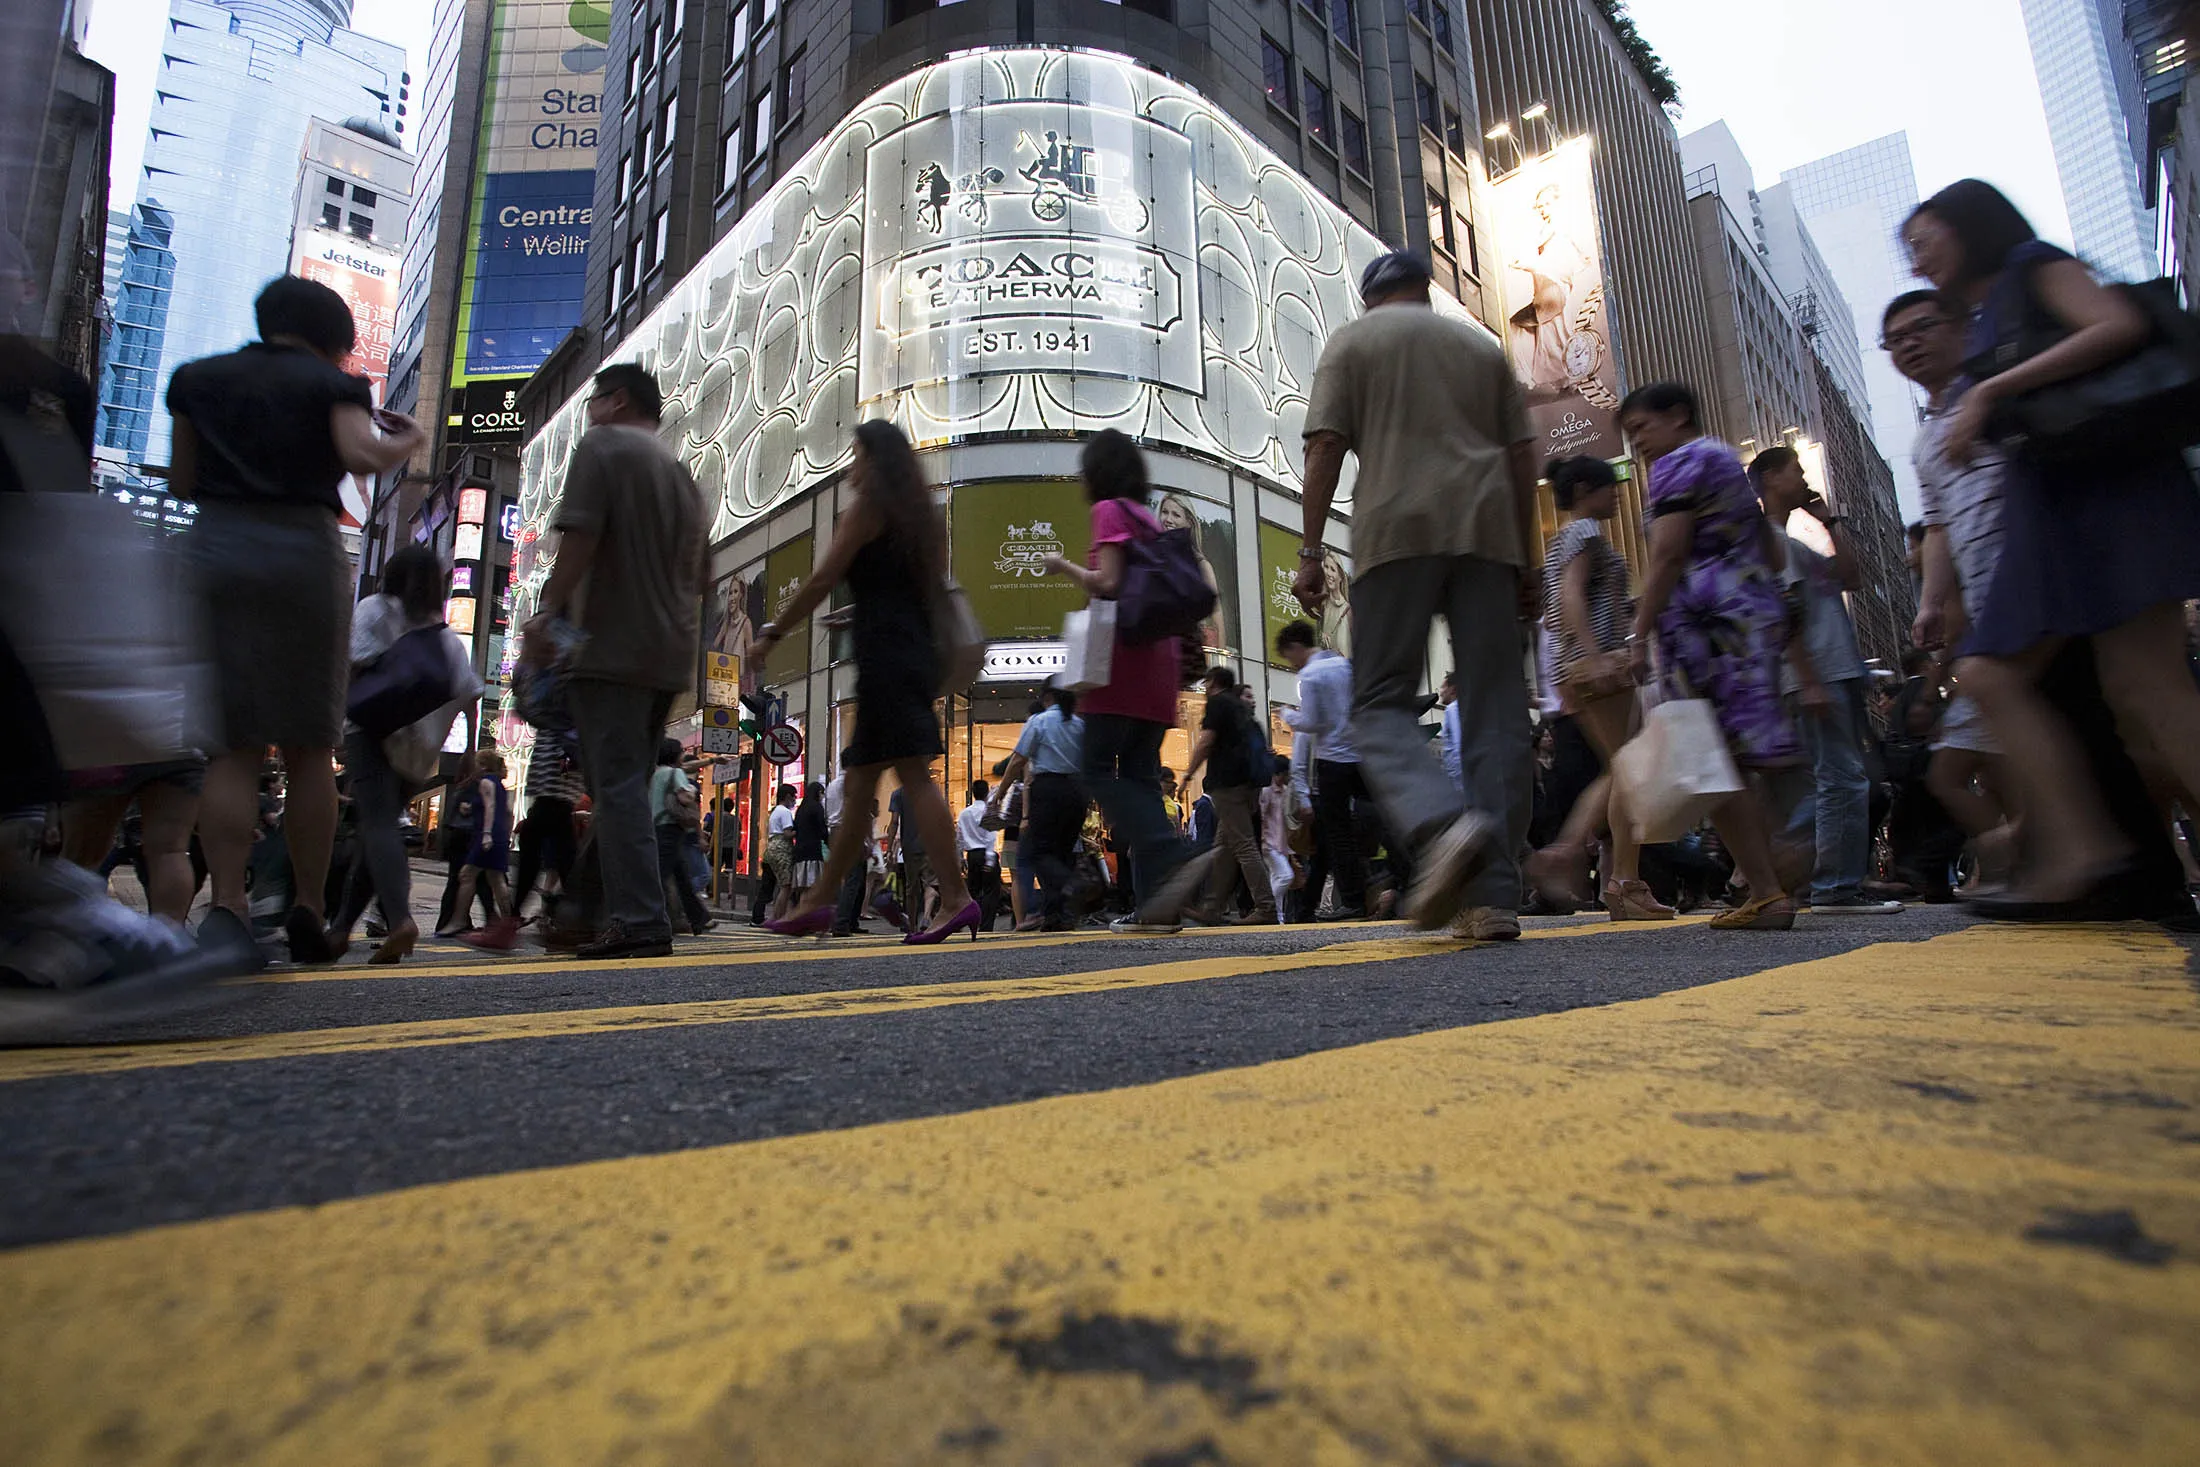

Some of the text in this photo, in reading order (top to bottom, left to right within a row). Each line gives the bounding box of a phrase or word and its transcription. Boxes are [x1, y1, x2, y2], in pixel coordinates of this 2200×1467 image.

[541, 88, 604, 114] Sta
[322, 248, 387, 278] Jetstar
[904, 252, 1153, 296] COACH
[965, 331, 1090, 355] EST. 1941
[1550, 419, 1593, 438] OMEGA
[1544, 431, 1602, 457] Ladymatic
[1007, 544, 1057, 552] COACH
[727, 697, 737, 706] 12
[726, 730, 733, 739] 7
[726, 743, 733, 752] 7
